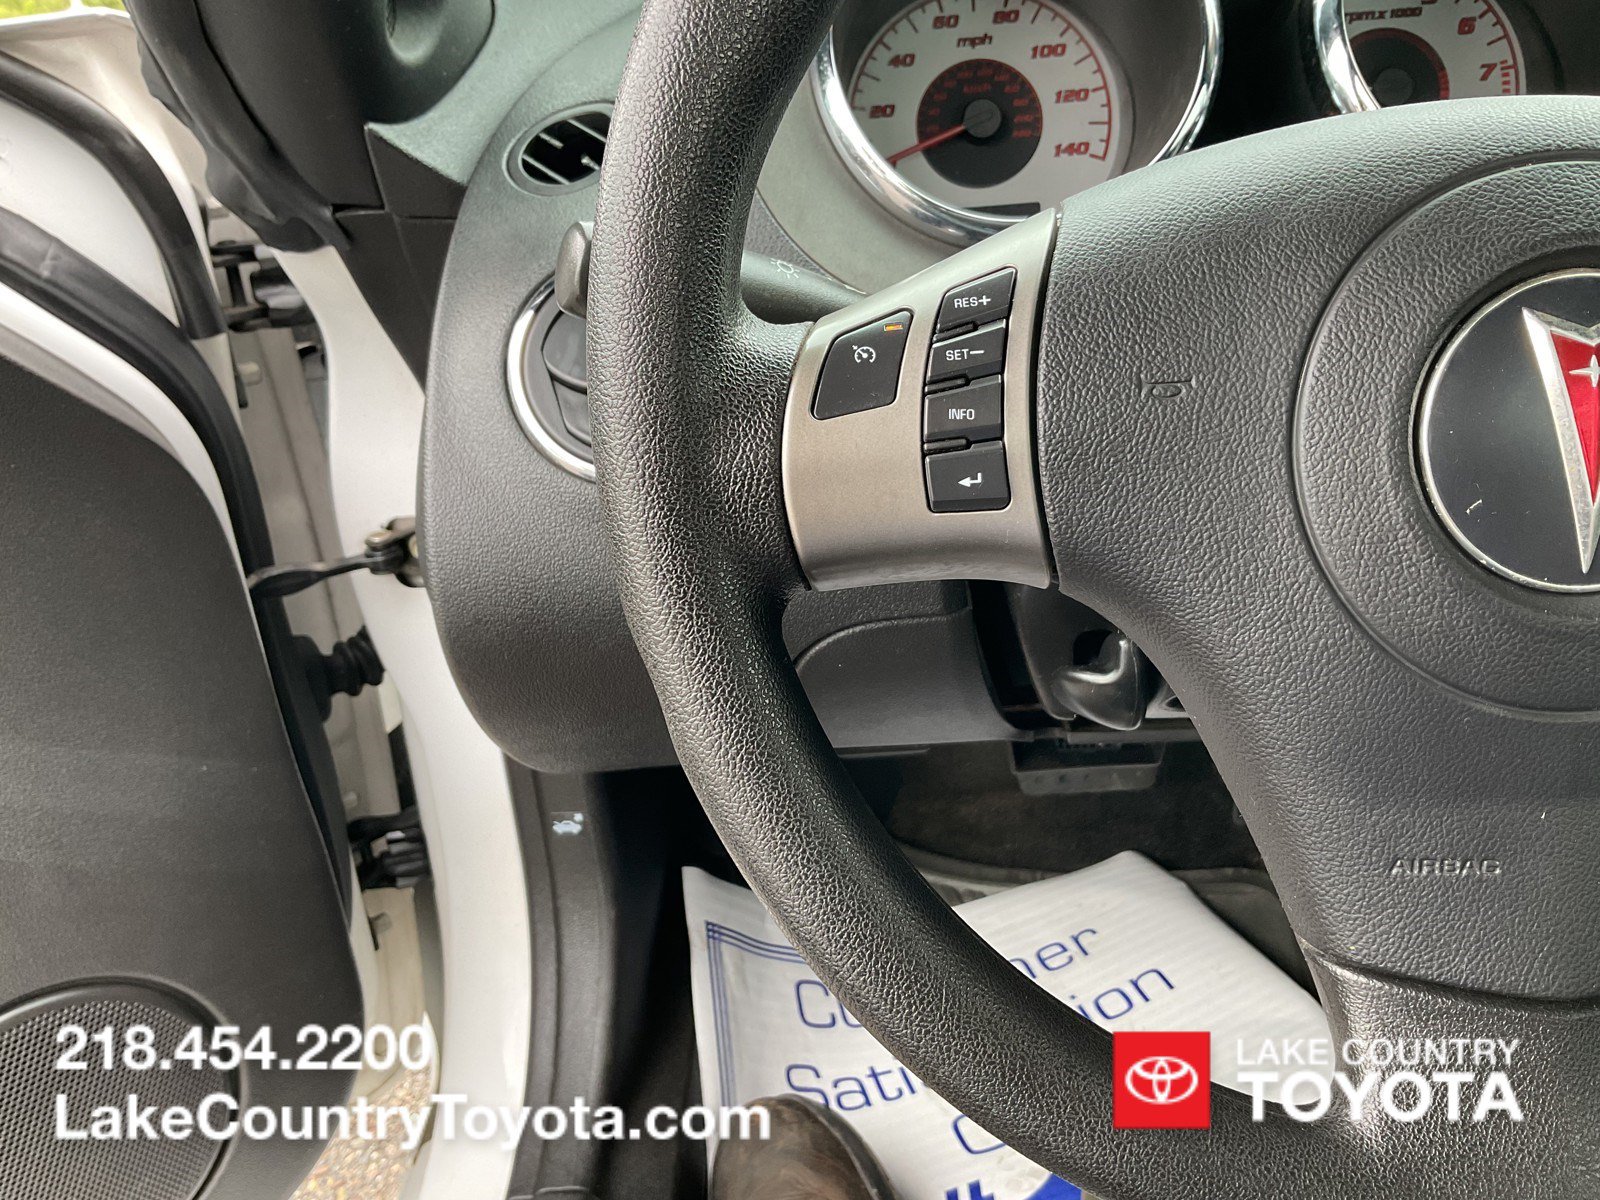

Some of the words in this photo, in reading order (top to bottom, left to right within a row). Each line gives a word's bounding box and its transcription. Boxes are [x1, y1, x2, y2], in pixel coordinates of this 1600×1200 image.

[992, 9, 1020, 25] 80
[1390, 6, 1422, 19] 1000
[932, 14, 959, 29] 60
[1457, 16, 1477, 35] 6
[956, 33, 993, 48] mph
[1030, 43, 1067, 60] 100
[887, 53, 915, 68] 40
[1479, 63, 1498, 82] 7
[1054, 88, 1090, 104] 120
[869, 104, 895, 119] 20
[1054, 142, 1090, 158] 140
[947, 407, 975, 421] INFO
[1390, 858, 1502, 877] AIRBAG
